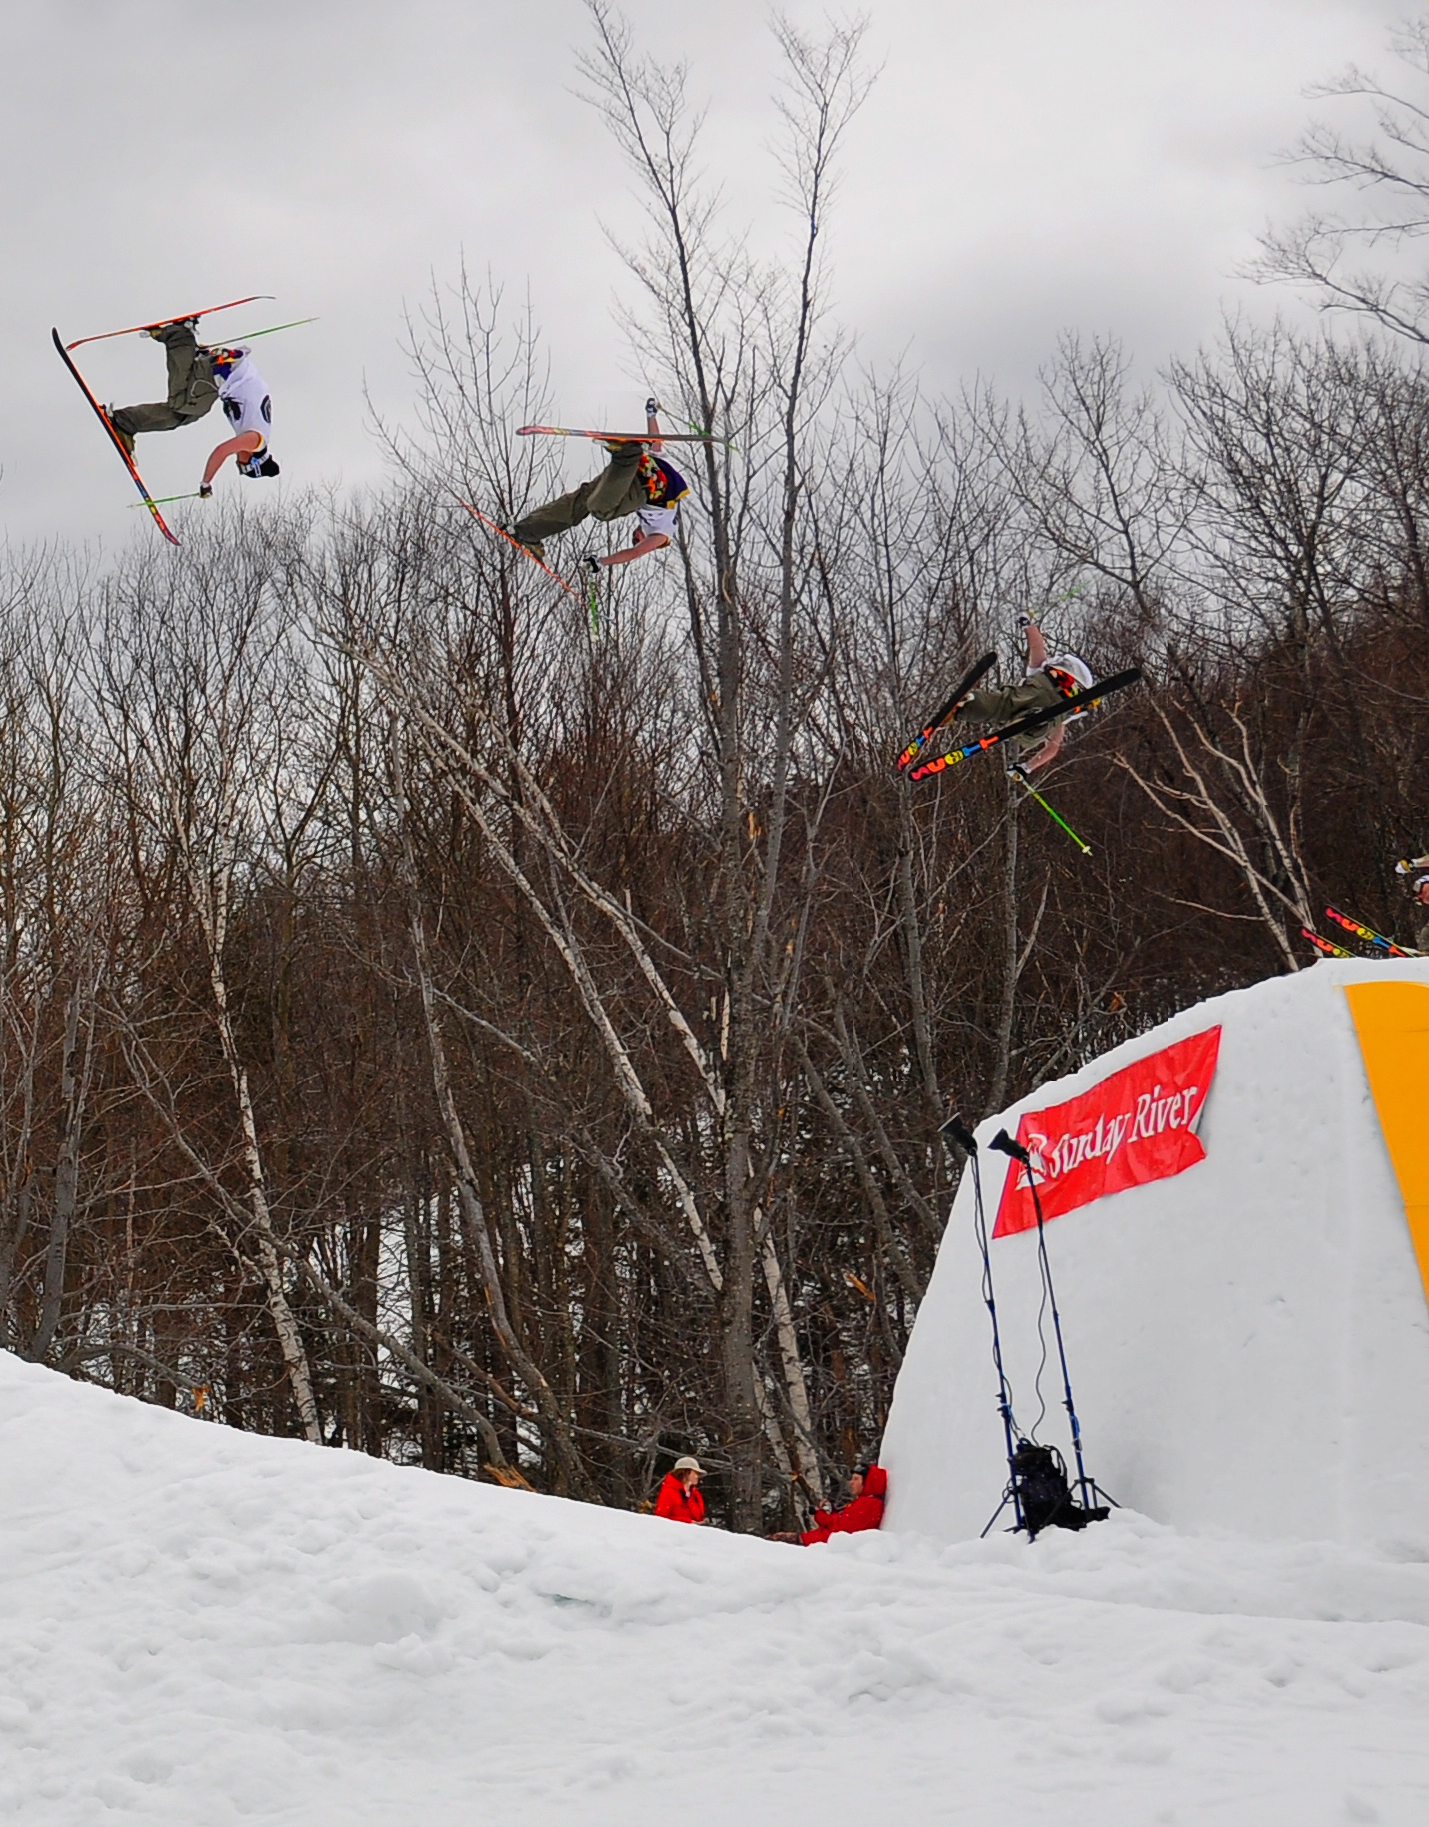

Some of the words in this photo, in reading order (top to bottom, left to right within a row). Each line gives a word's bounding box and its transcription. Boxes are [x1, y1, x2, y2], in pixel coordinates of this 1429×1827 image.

[910, 735, 1000, 781] SCOTT
[1049, 1113, 1132, 1179] Sunday
[1127, 1084, 1198, 1143] River
